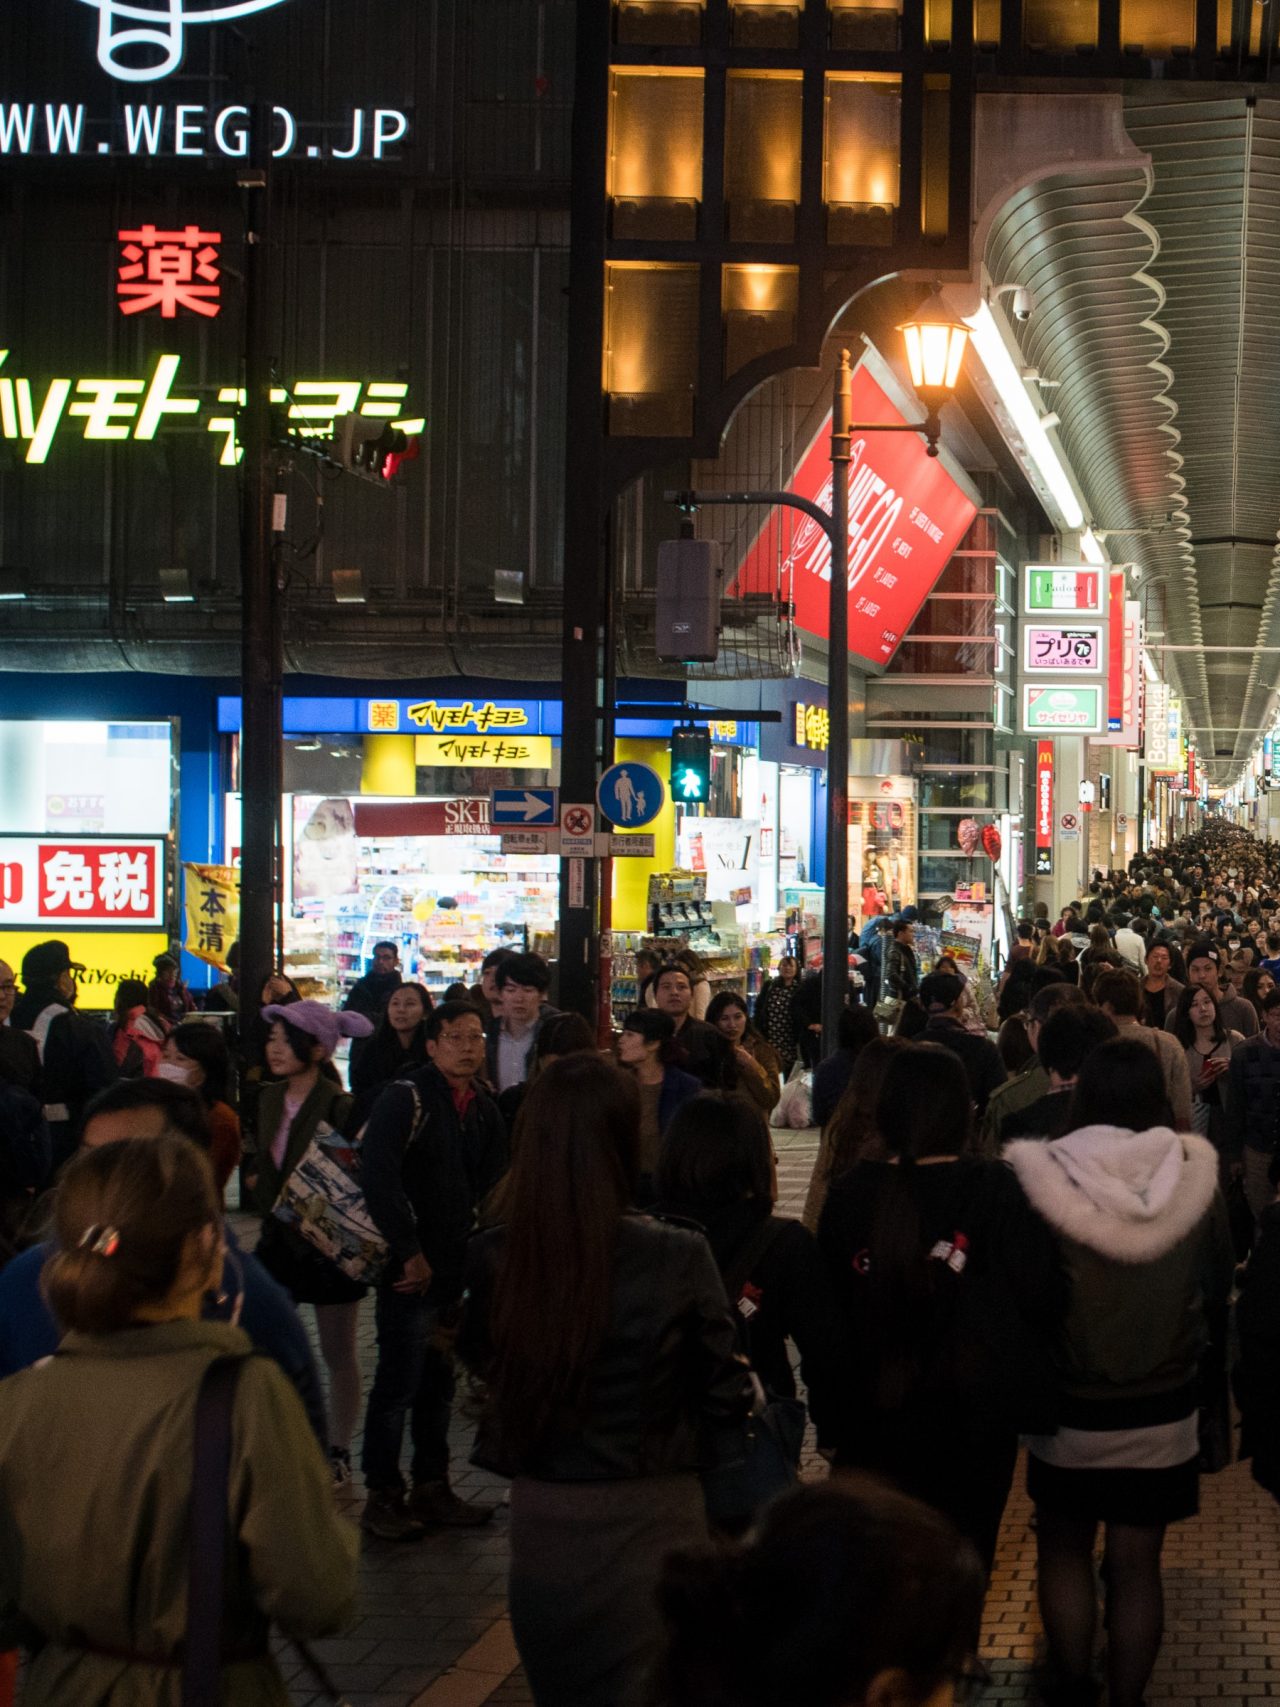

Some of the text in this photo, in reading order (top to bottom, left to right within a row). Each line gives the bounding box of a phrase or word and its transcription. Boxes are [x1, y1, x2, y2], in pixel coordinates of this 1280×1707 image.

[117, 224, 221, 318] 薬
[1035, 638, 1072, 658] プリ
[371, 703, 525, 731] 薬 マツモトキヨシ
[1107, 722, 1121, 730] PEN
[1147, 687, 1167, 764] Bershka
[438, 739, 530, 763] マツモトキヨシ
[1037, 860, 1051, 871] 24
[43, 850, 149, 912] 免税
[198, 874, 227, 953] 本清
